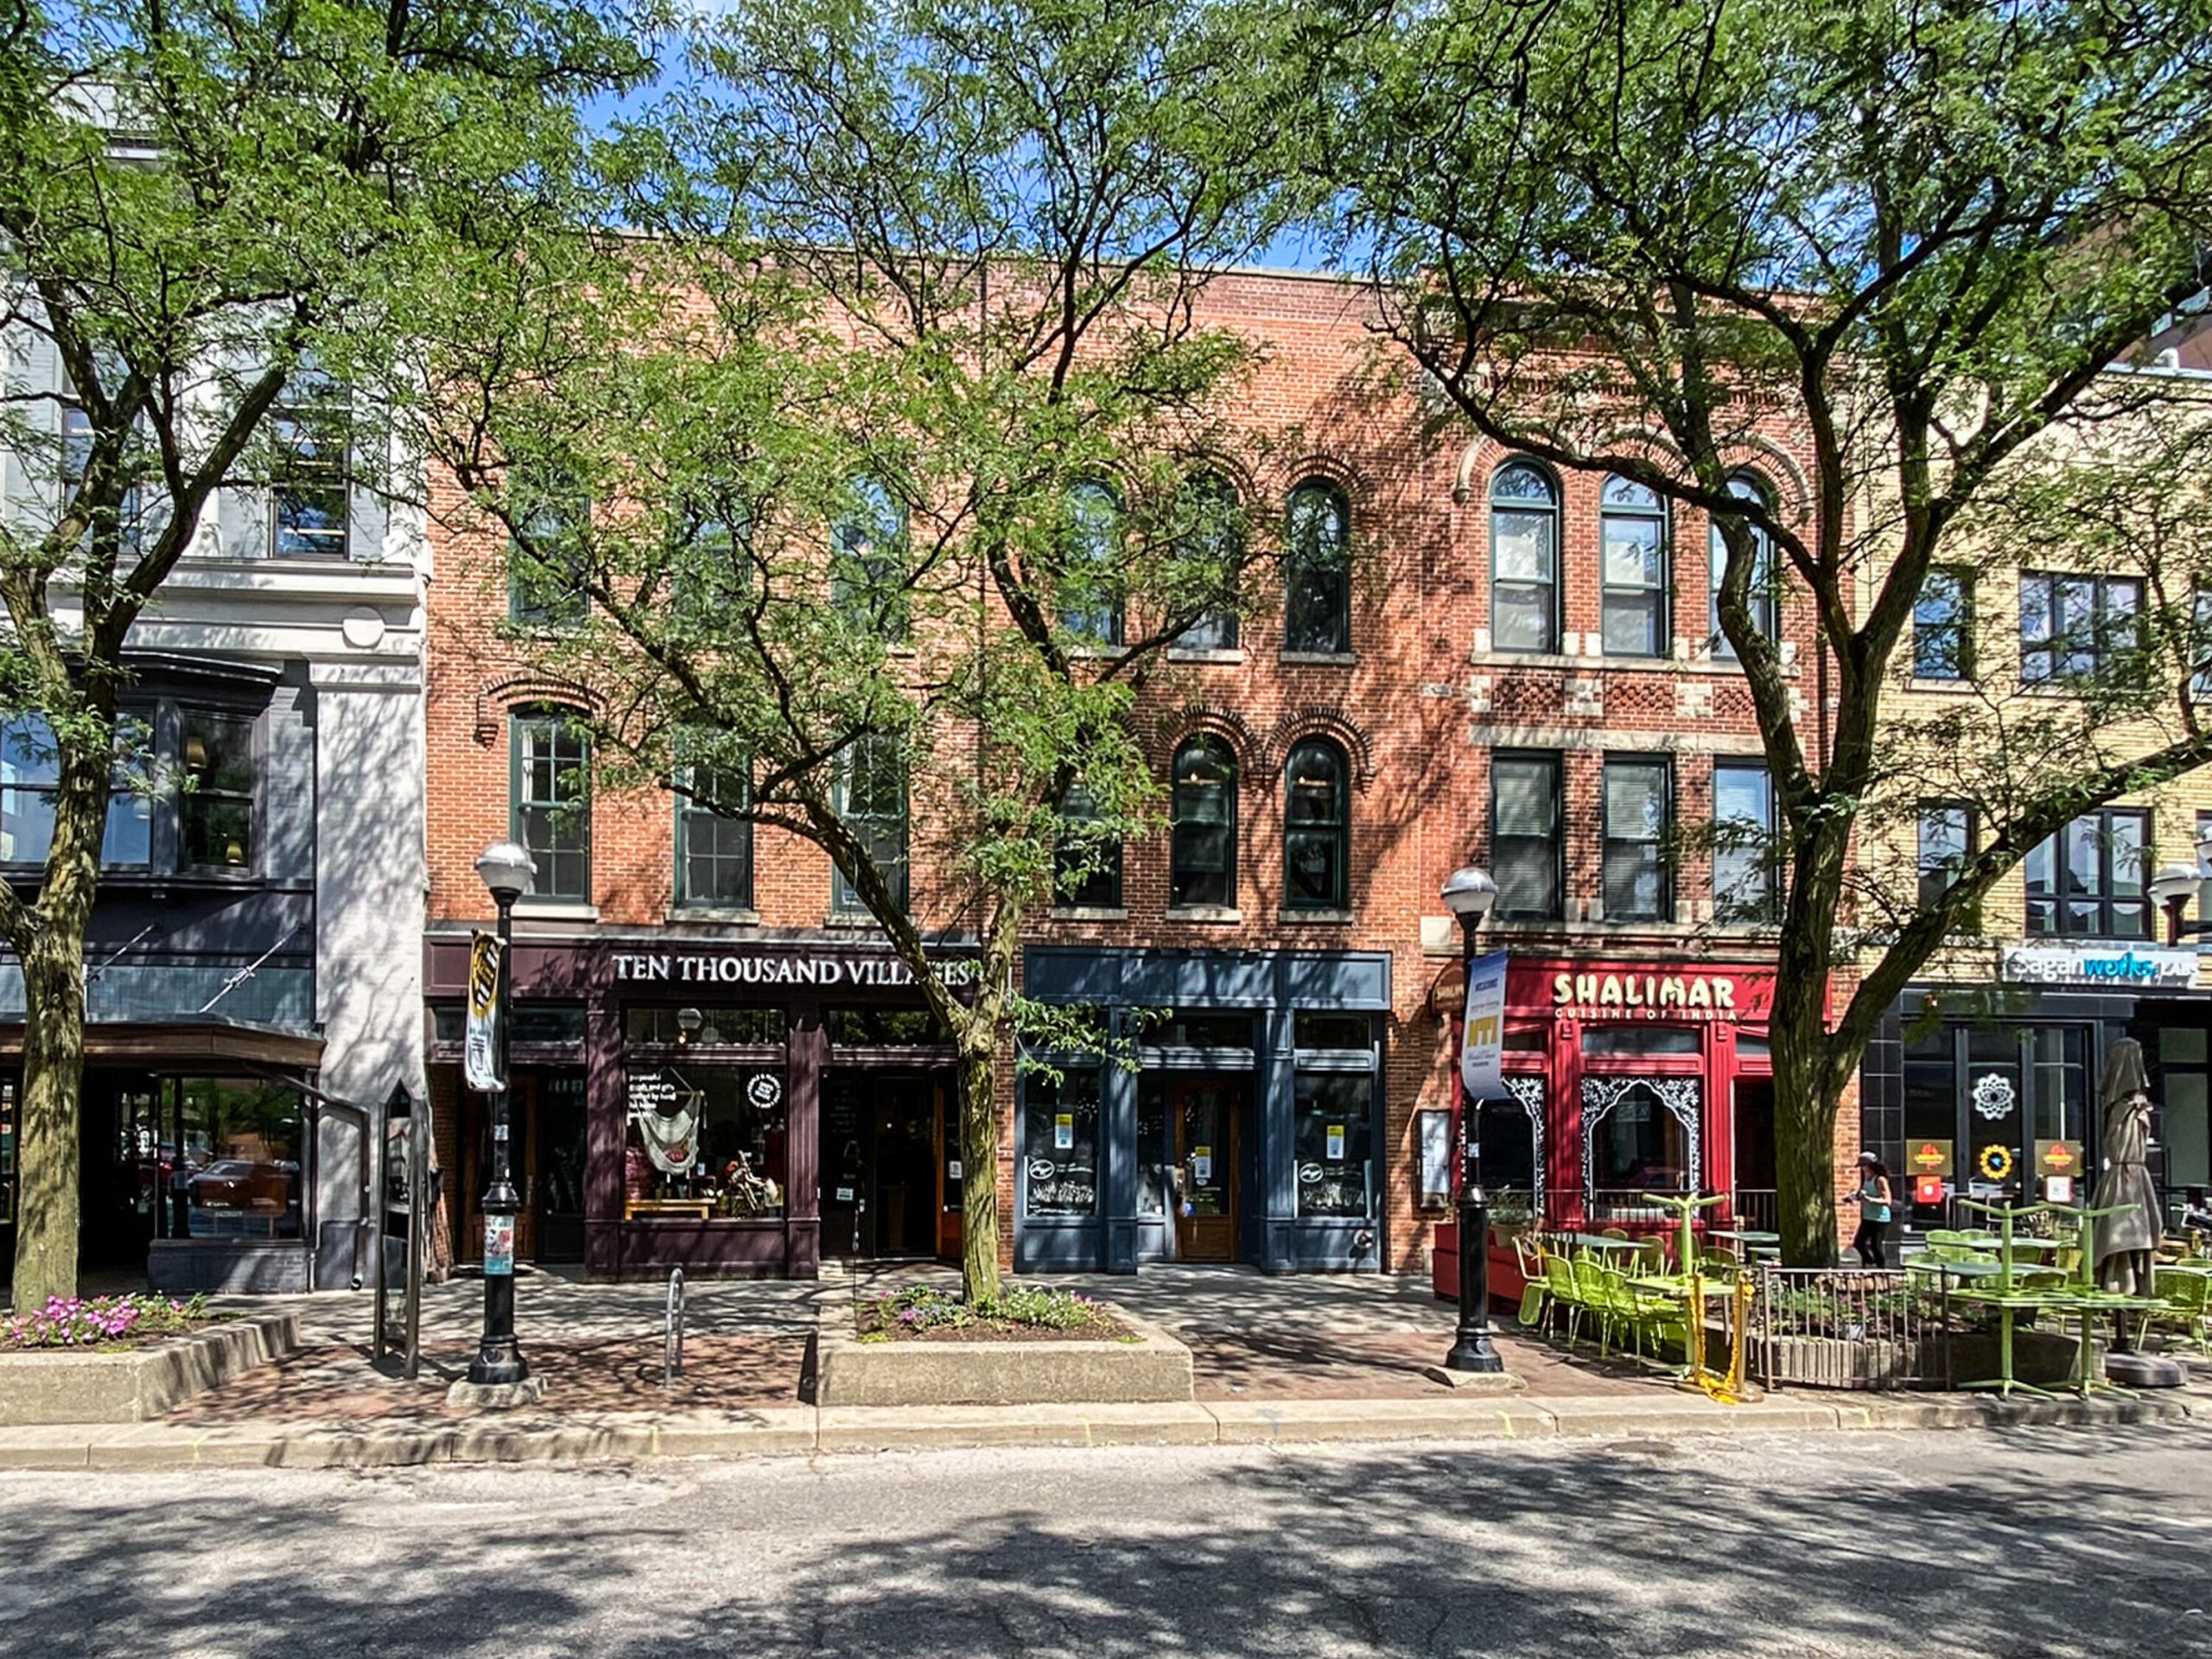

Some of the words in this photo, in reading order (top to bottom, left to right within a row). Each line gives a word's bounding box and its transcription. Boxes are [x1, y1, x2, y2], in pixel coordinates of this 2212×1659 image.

[611, 954, 671, 981] TEN
[677, 956, 842, 983] THOUSAND
[1554, 974, 1735, 1008] SHALIMAR
[1555, 1009, 1632, 1020] CUISINE
[1647, 1010, 1668, 1020] OF
[1681, 1010, 1737, 1021] INDIA
